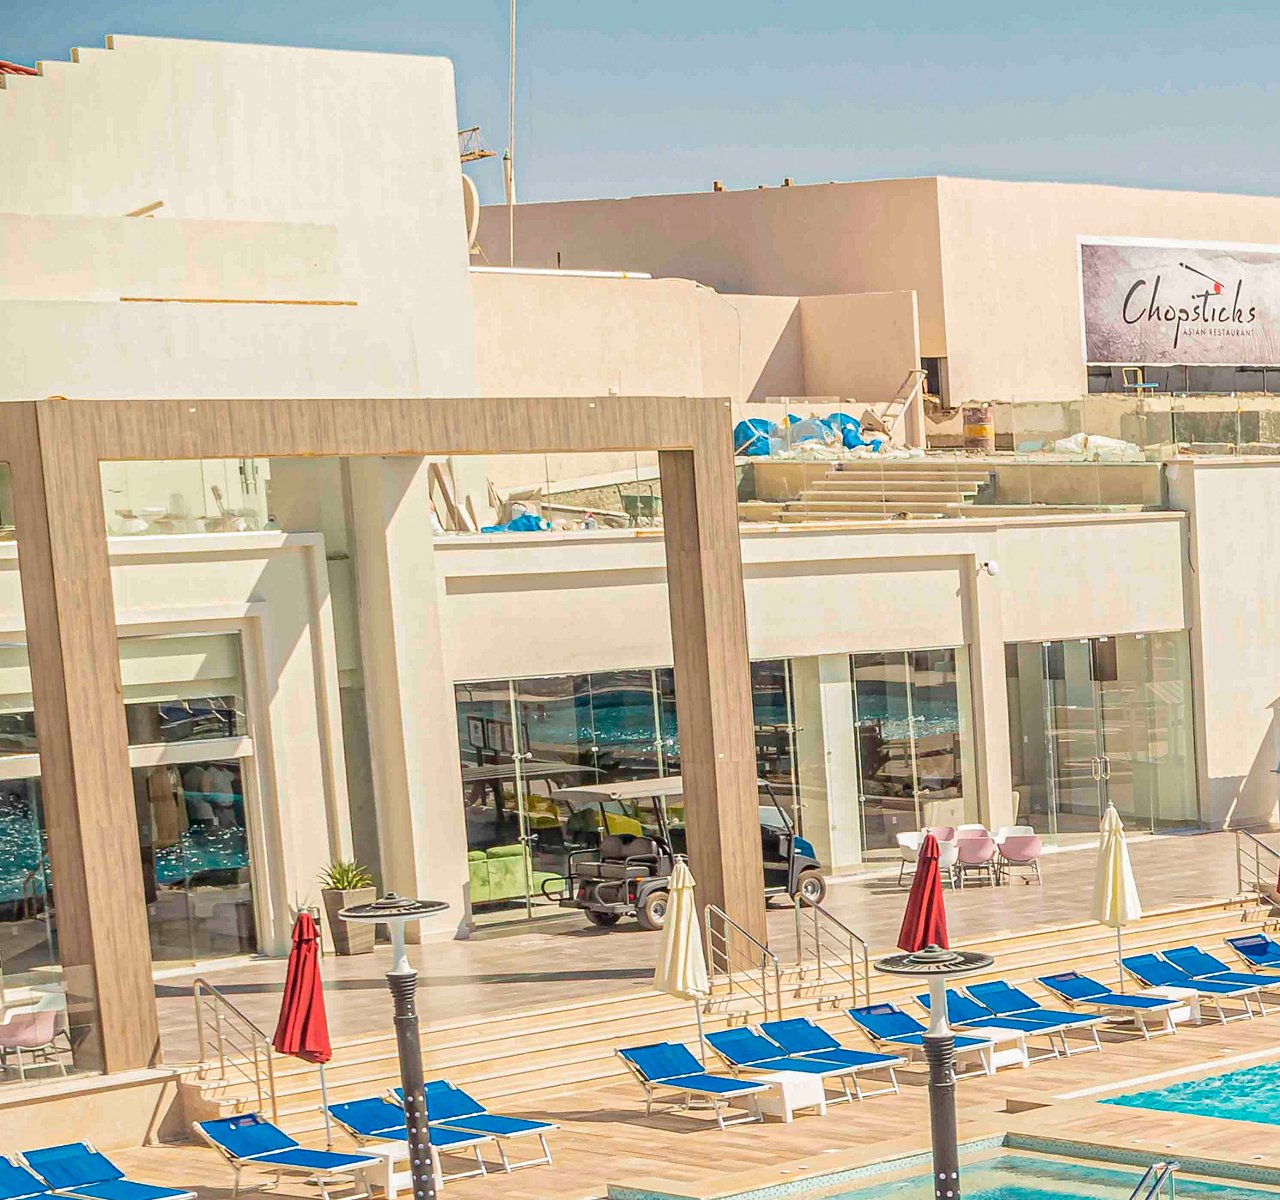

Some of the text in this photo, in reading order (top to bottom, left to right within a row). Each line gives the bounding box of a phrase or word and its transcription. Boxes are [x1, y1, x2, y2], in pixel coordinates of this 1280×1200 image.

[1123, 274, 1256, 349] Chopsticks
[1183, 328, 1255, 337] ASIAN RESTAURANT
